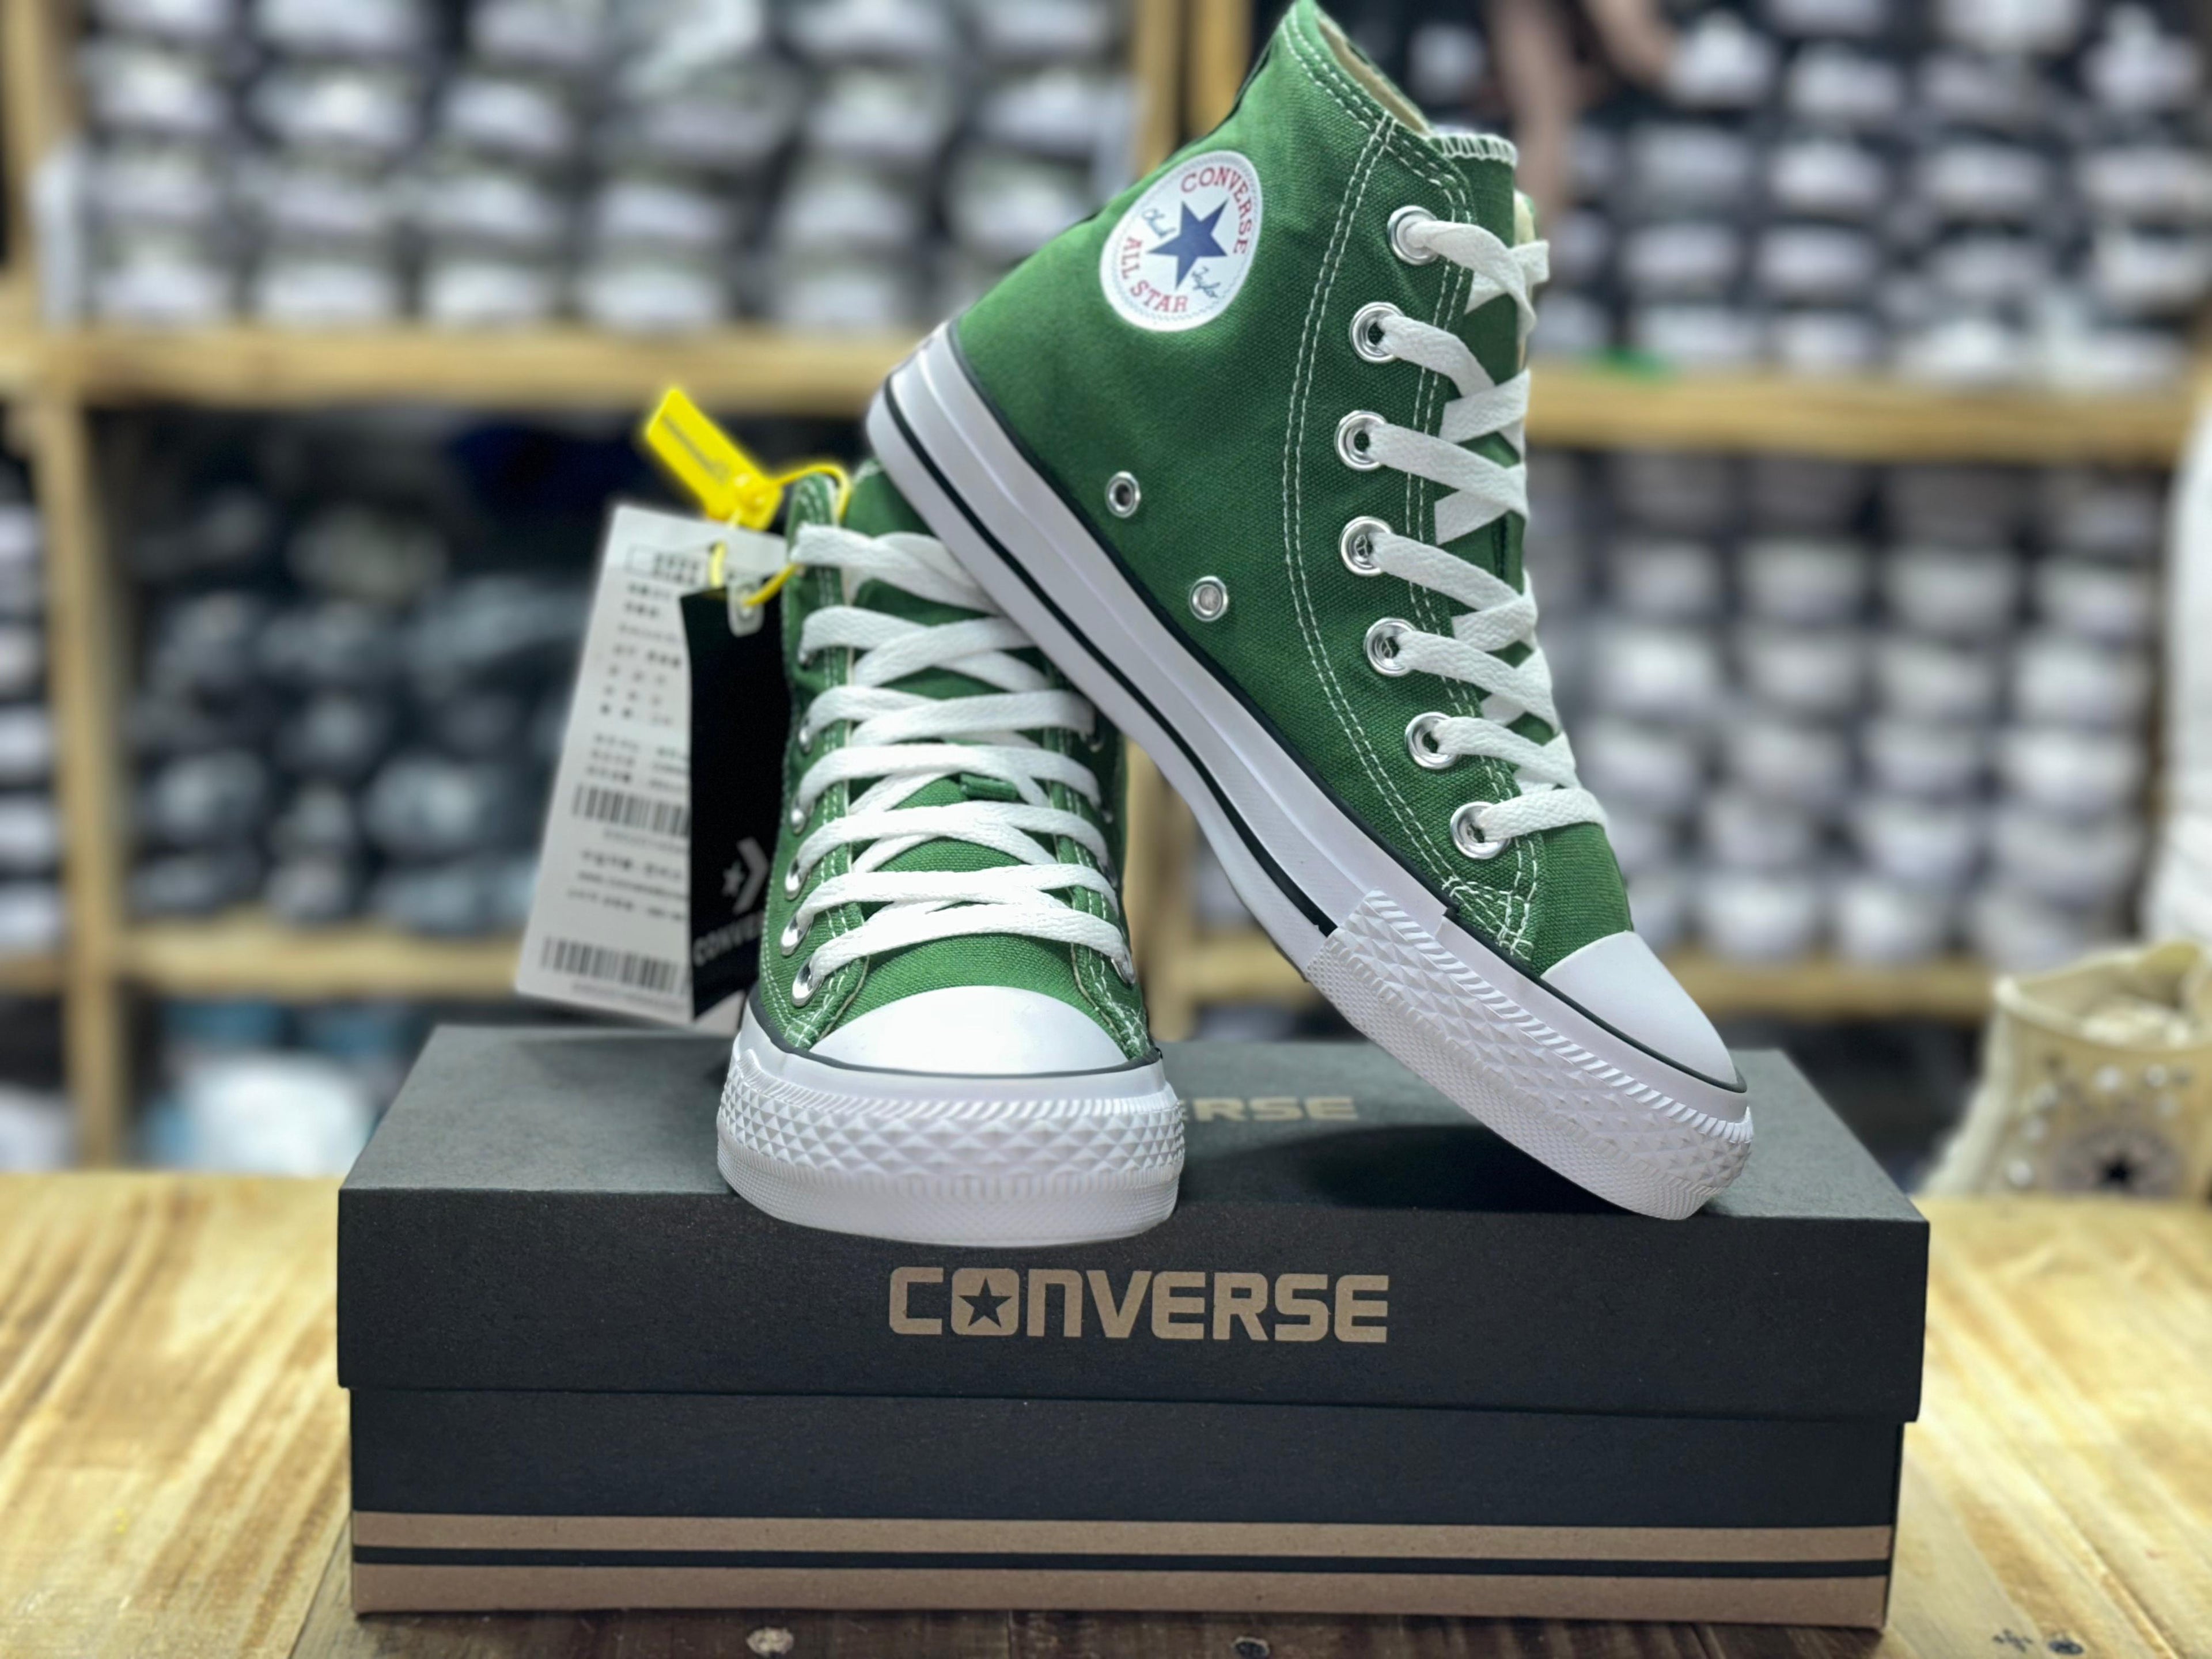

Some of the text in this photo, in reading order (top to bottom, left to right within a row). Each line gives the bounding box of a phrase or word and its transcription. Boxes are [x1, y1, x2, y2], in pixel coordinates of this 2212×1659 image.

[1181, 166, 1253, 255] CONVERSE
[1121, 236, 1143, 280] ALL
[1130, 279, 1189, 313] STAR
[889, 1267, 1389, 1343] CONVERSE
